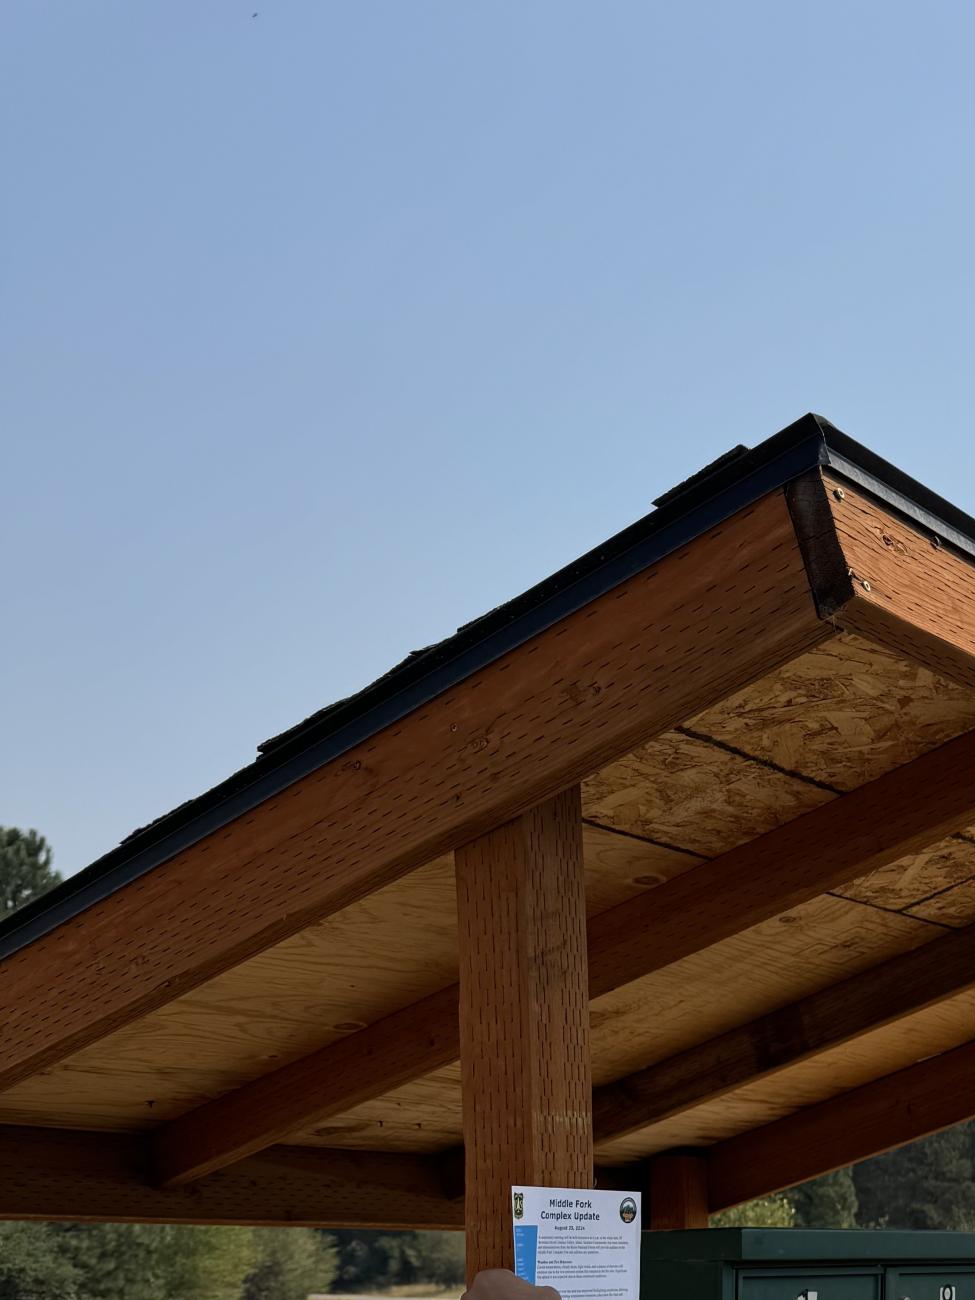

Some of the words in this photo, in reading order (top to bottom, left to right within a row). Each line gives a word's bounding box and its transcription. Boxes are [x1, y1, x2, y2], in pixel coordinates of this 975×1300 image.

[549, 1199, 573, 1209] Middle
[575, 1200, 592, 1209] Fork
[540, 1210, 572, 1220] Complex
[574, 1212, 600, 1222] Update
